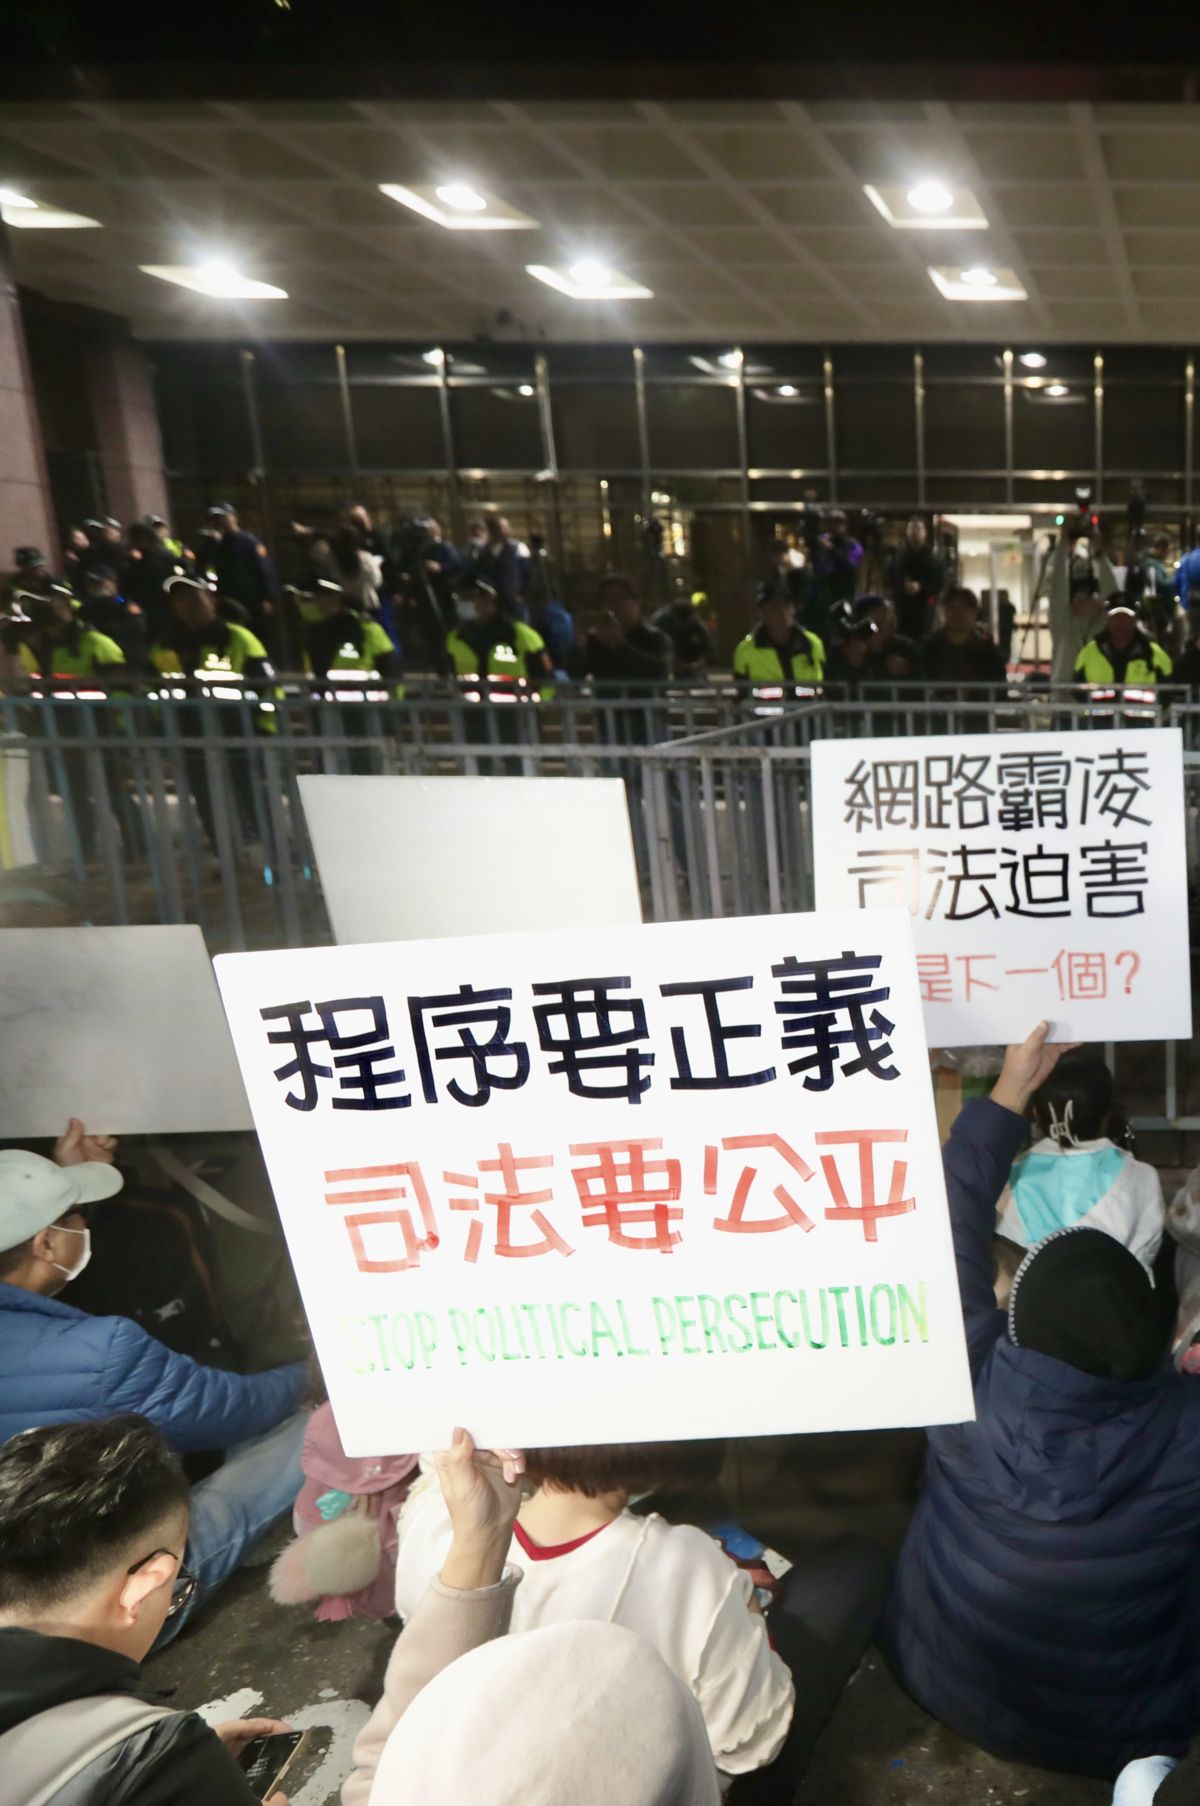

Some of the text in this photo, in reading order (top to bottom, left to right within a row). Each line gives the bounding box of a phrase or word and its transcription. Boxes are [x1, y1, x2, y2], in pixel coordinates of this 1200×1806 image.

[844, 747, 1153, 833] 網路霸凌
[847, 839, 1149, 920] 司法迫害
[259, 950, 902, 1112] 程序要正義
[323, 1128, 917, 1274] 司法要公平
[447, 1298, 651, 1366] POLITICAL
[651, 1280, 931, 1357] PERSECUTION
